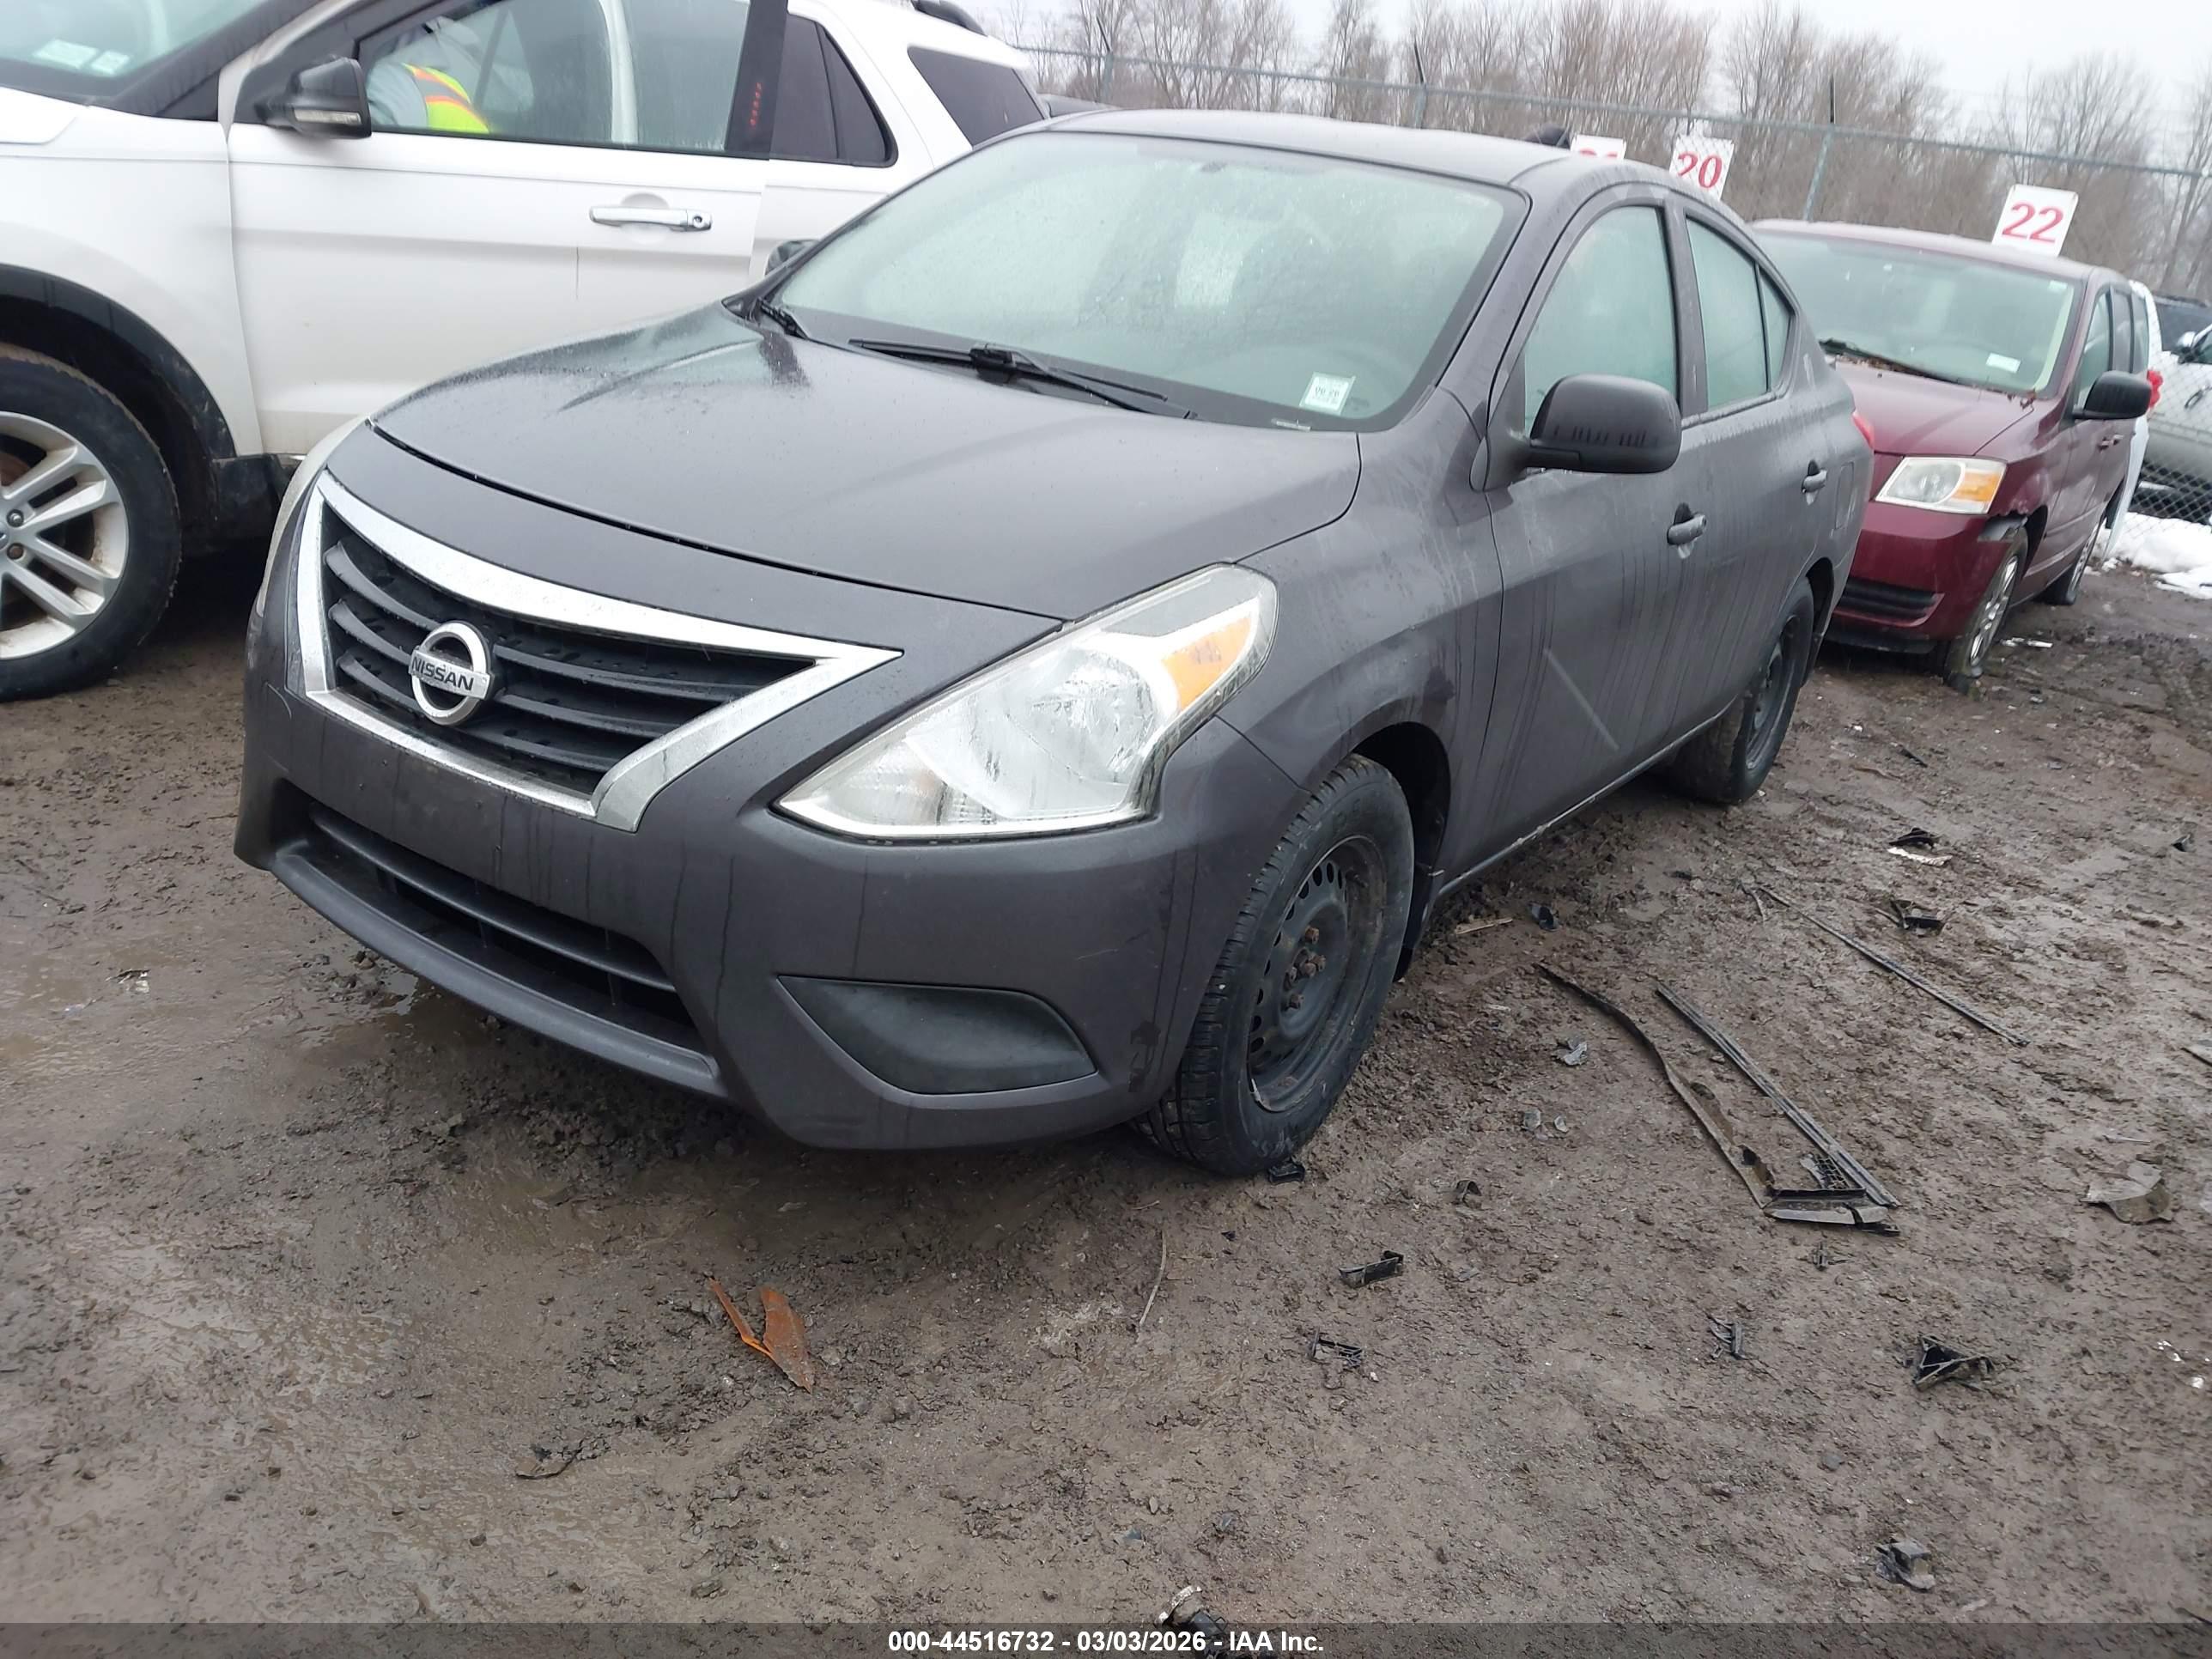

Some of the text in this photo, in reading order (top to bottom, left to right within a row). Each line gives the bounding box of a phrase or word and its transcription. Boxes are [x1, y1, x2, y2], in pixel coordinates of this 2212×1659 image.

[1677, 151, 1723, 189] 20
[2002, 203, 2064, 244] 22
[411, 656, 475, 691] NISSAN
